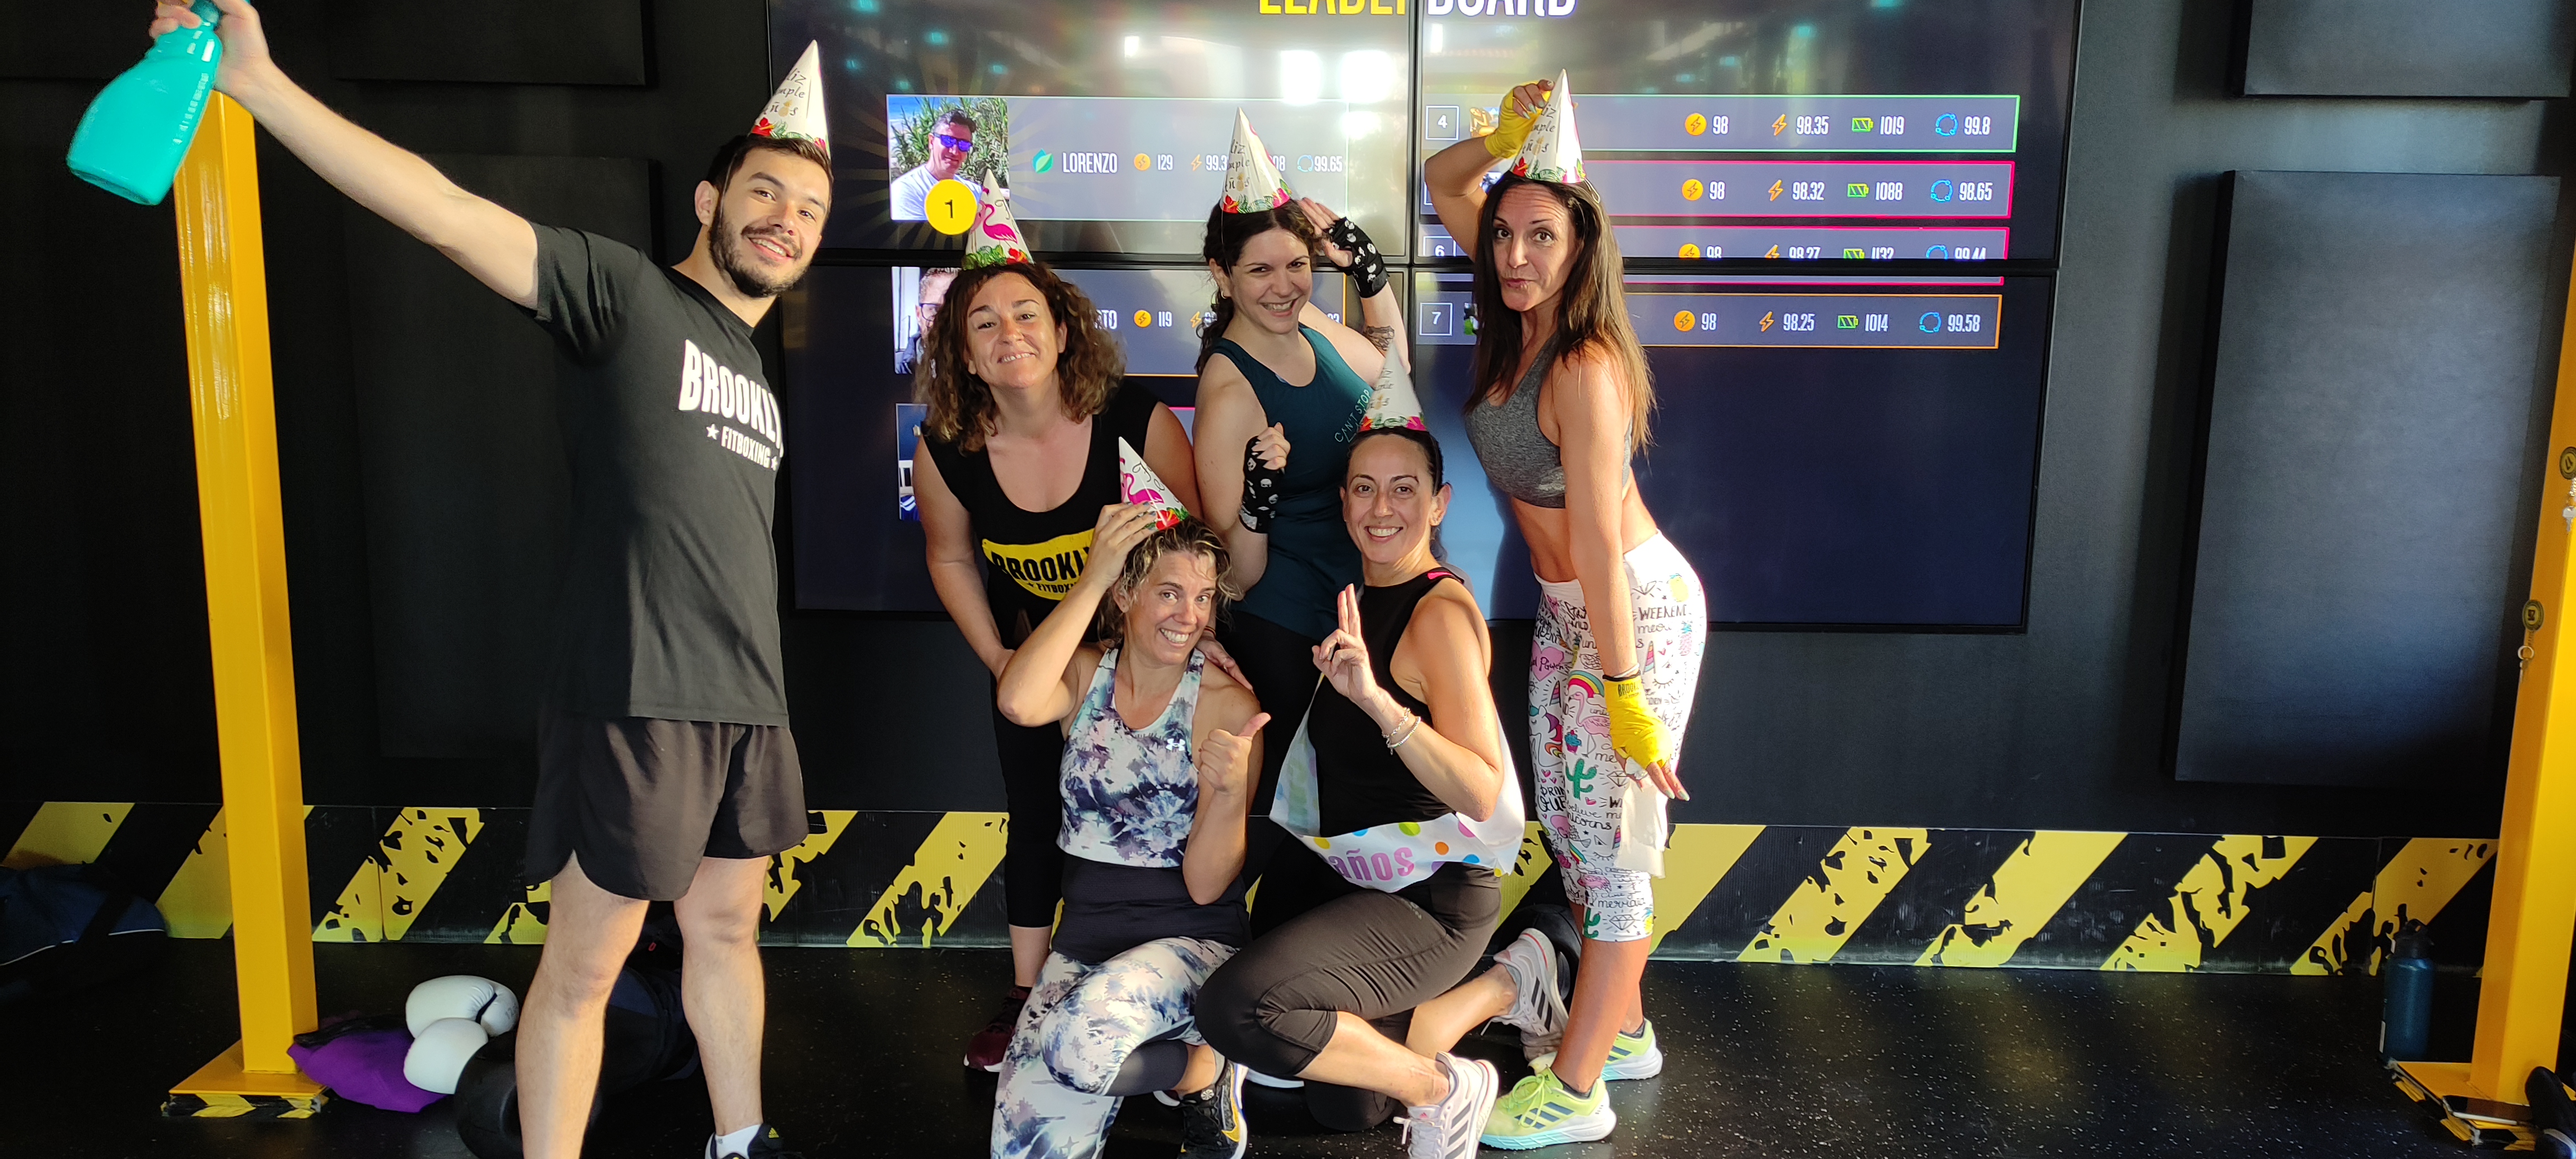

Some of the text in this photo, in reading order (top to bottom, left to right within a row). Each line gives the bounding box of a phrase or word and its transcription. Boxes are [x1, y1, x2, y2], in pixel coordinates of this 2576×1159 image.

[1437, 115, 1448, 128] 4
[1713, 115, 1990, 135] 98 98.35 1019 99.8
[1062, 153, 1118, 174] LORENZO
[1157, 154, 1173, 171] 129
[1314, 155, 1343, 172] 99.65
[1709, 181, 1993, 201] 98 98.32 1088 98.65
[945, 199, 954, 218] 1
[1158, 311, 1172, 327] 119
[1432, 311, 1441, 325] 7
[1701, 312, 1980, 332] 98 98.25 1014 99.58
[678, 339, 784, 457] BROOKLY
[1355, 389, 1371, 415] STOP
[721, 426, 771, 469] FITBOXING
